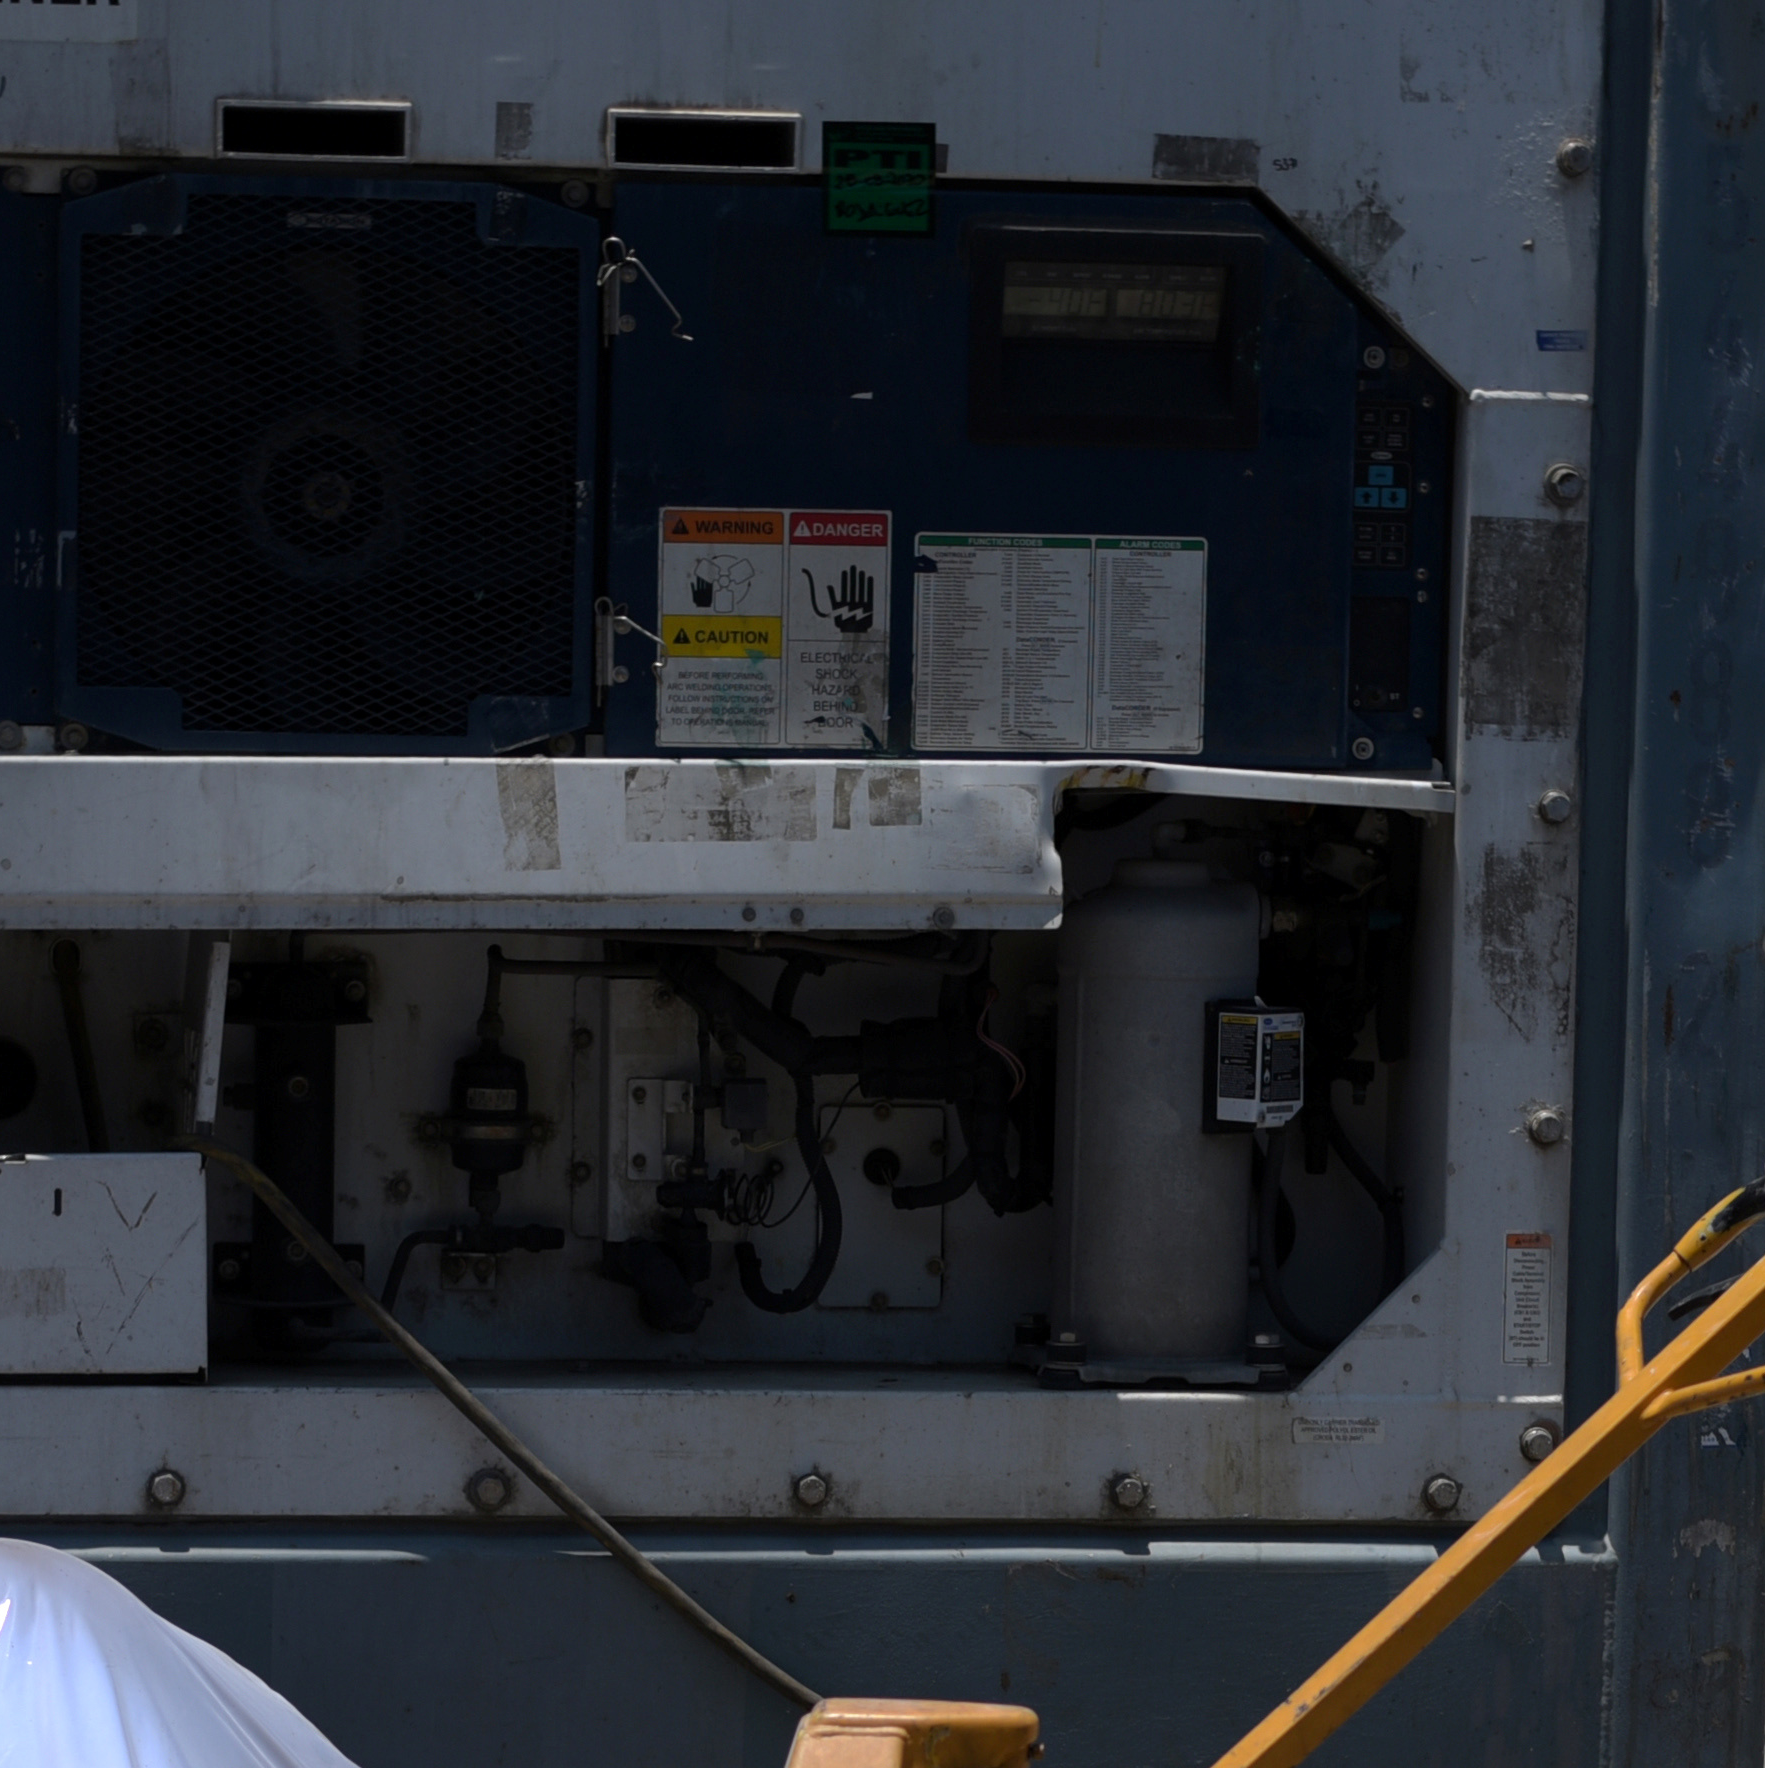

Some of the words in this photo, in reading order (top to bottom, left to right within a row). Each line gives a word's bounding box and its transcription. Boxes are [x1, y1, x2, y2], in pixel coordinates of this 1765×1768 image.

[834, 148, 922, 170] PTI
[696, 520, 774, 535] WARNING
[812, 523, 883, 537] DANGER
[968, 538, 1011, 546] FUNCTION
[1013, 538, 1043, 547] CODES
[1119, 540, 1150, 549] ALARM
[1152, 541, 1182, 549] CODES
[694, 630, 769, 644] CAUTION
[678, 671, 710, 680] BEFORE
[711, 671, 764, 680] PERFORMING
[815, 668, 858, 680] SHOCK
[686, 684, 722, 692] WELDING
[812, 684, 860, 696] HAZARD
[668, 694, 700, 702] FOLLOW
[702, 695, 760, 703] INSTRUCTIONS
[666, 706, 690, 714] LABEL
[813, 700, 859, 712] BEHIND
[672, 718, 682, 726] TO
